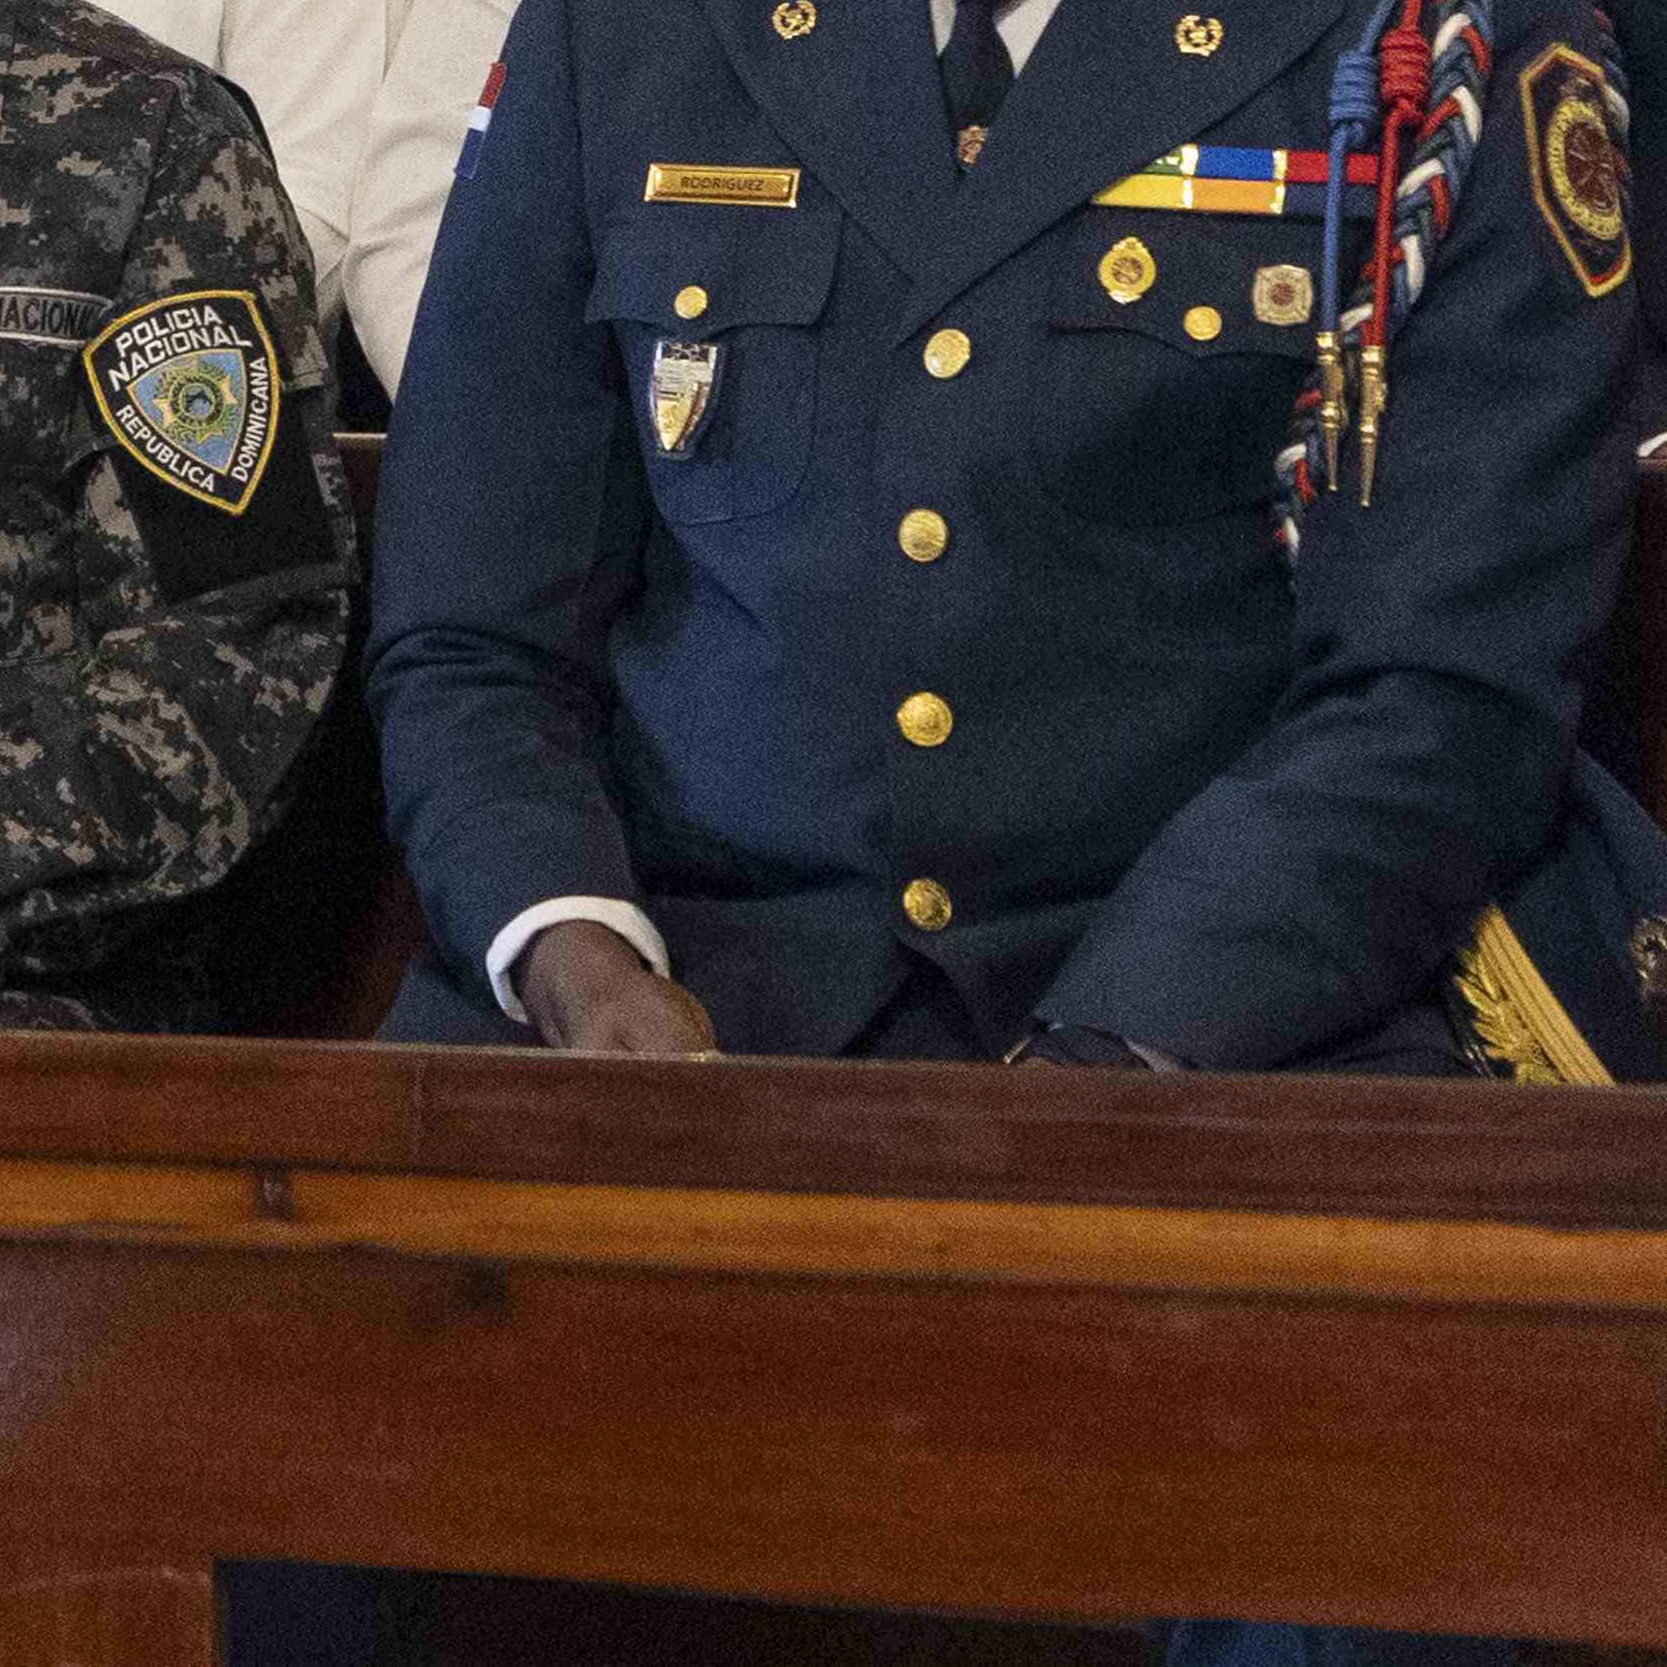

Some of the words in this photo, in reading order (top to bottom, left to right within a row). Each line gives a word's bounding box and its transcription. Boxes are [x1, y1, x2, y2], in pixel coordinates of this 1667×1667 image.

[680, 175, 765, 192] RODRIGUEZ
[107, 324, 254, 392] NACIONAL
[115, 304, 224, 359] POLICIA
[115, 404, 216, 493] REPUBLICA
[230, 356, 269, 484] DOMINICANA
